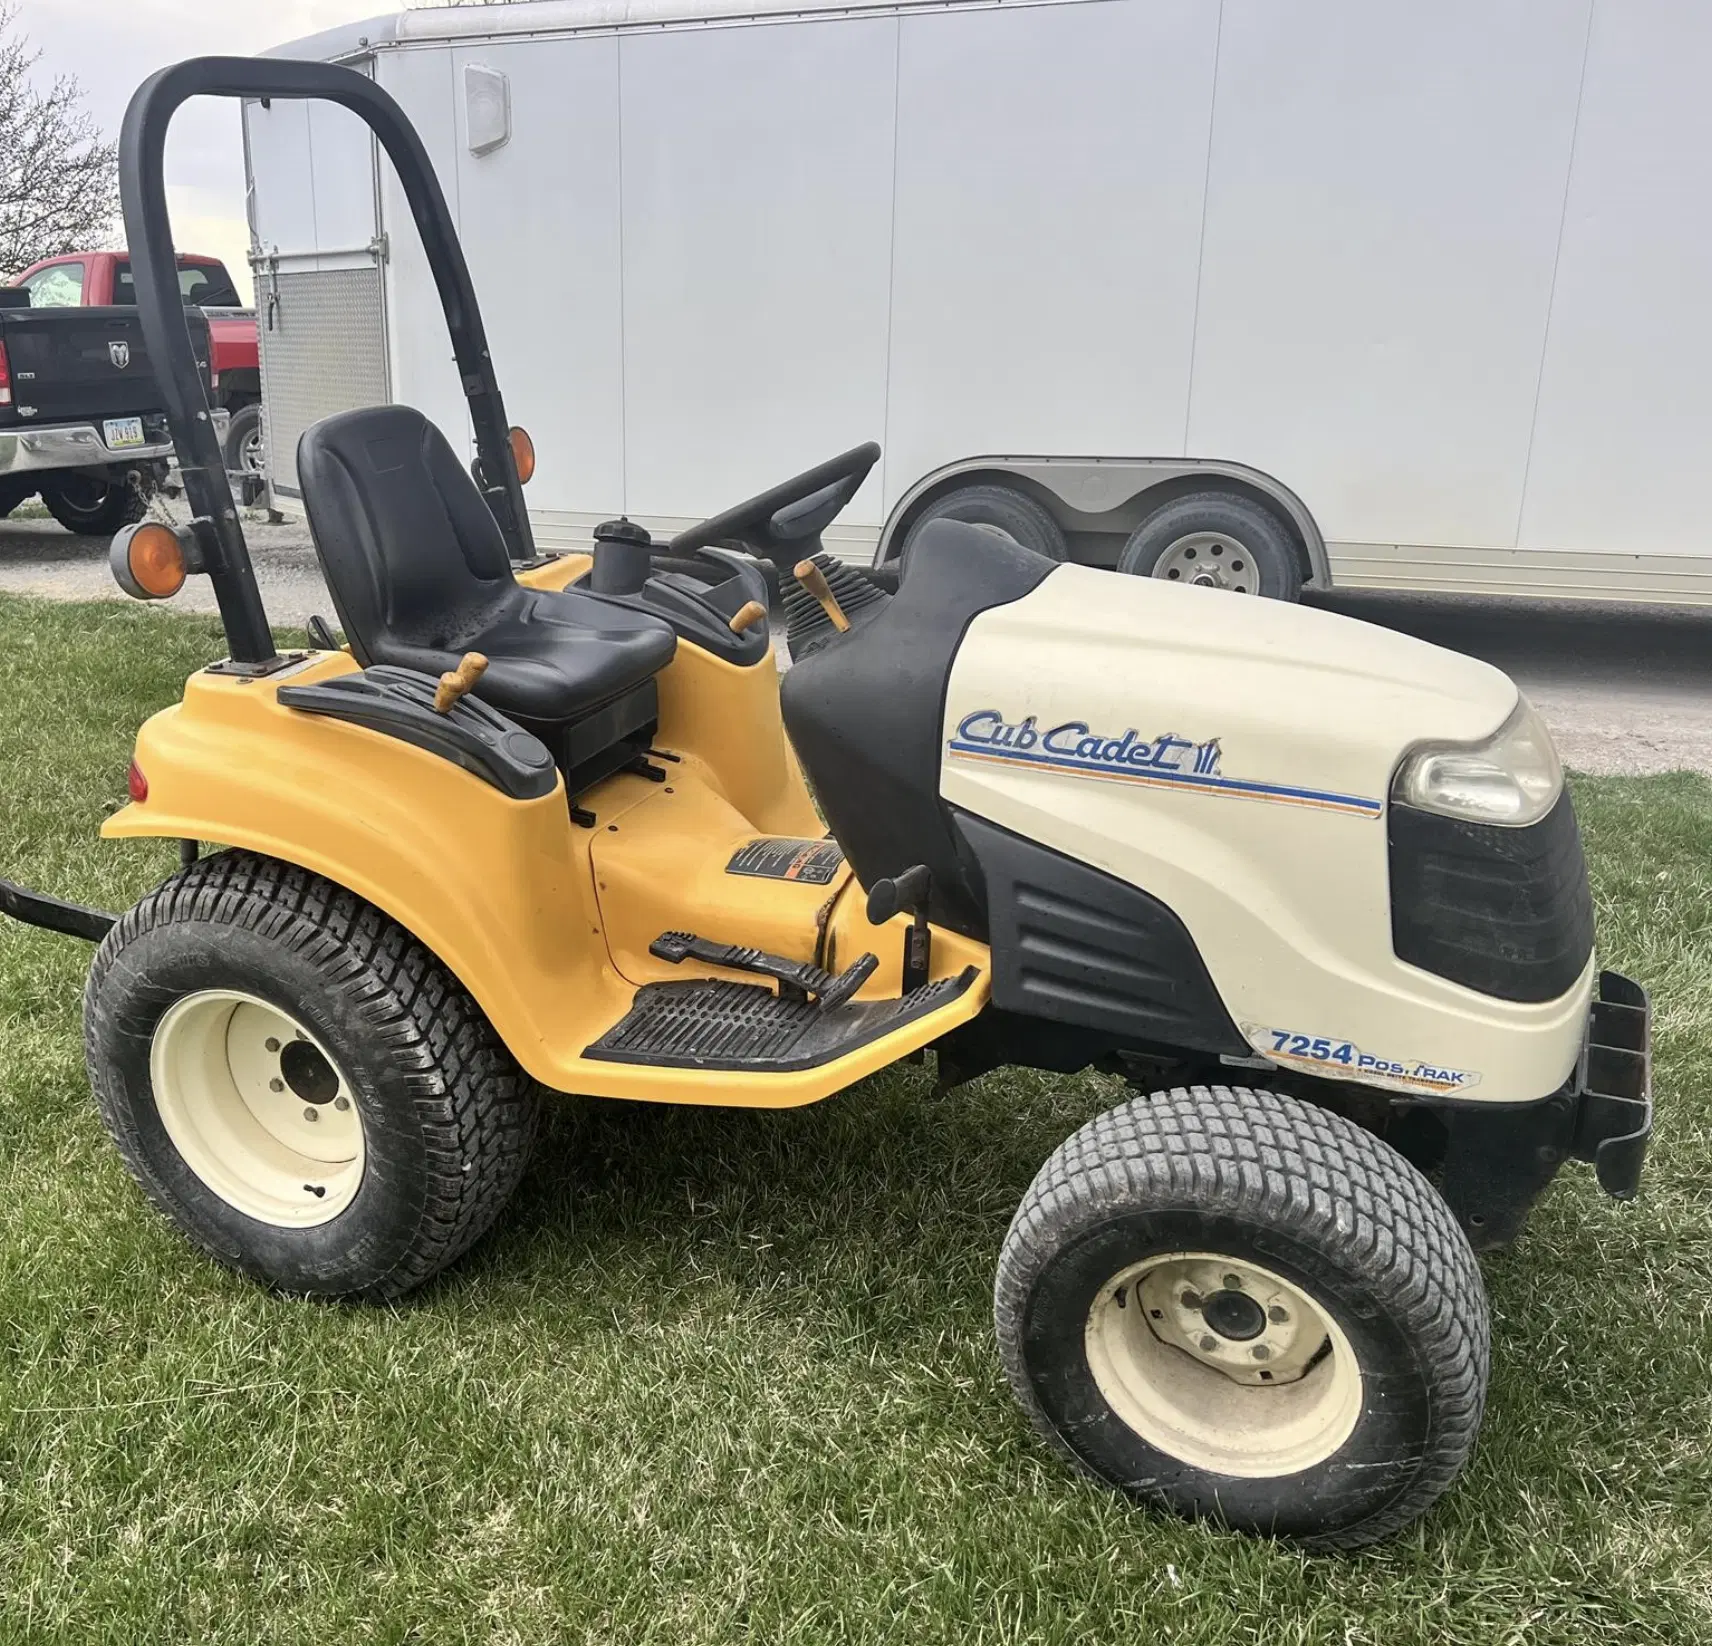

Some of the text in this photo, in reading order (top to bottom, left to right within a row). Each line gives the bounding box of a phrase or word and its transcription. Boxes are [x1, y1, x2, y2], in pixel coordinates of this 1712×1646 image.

[960, 711, 1192, 770] Cub Cadet
[1271, 1030, 1352, 1064] 7254
